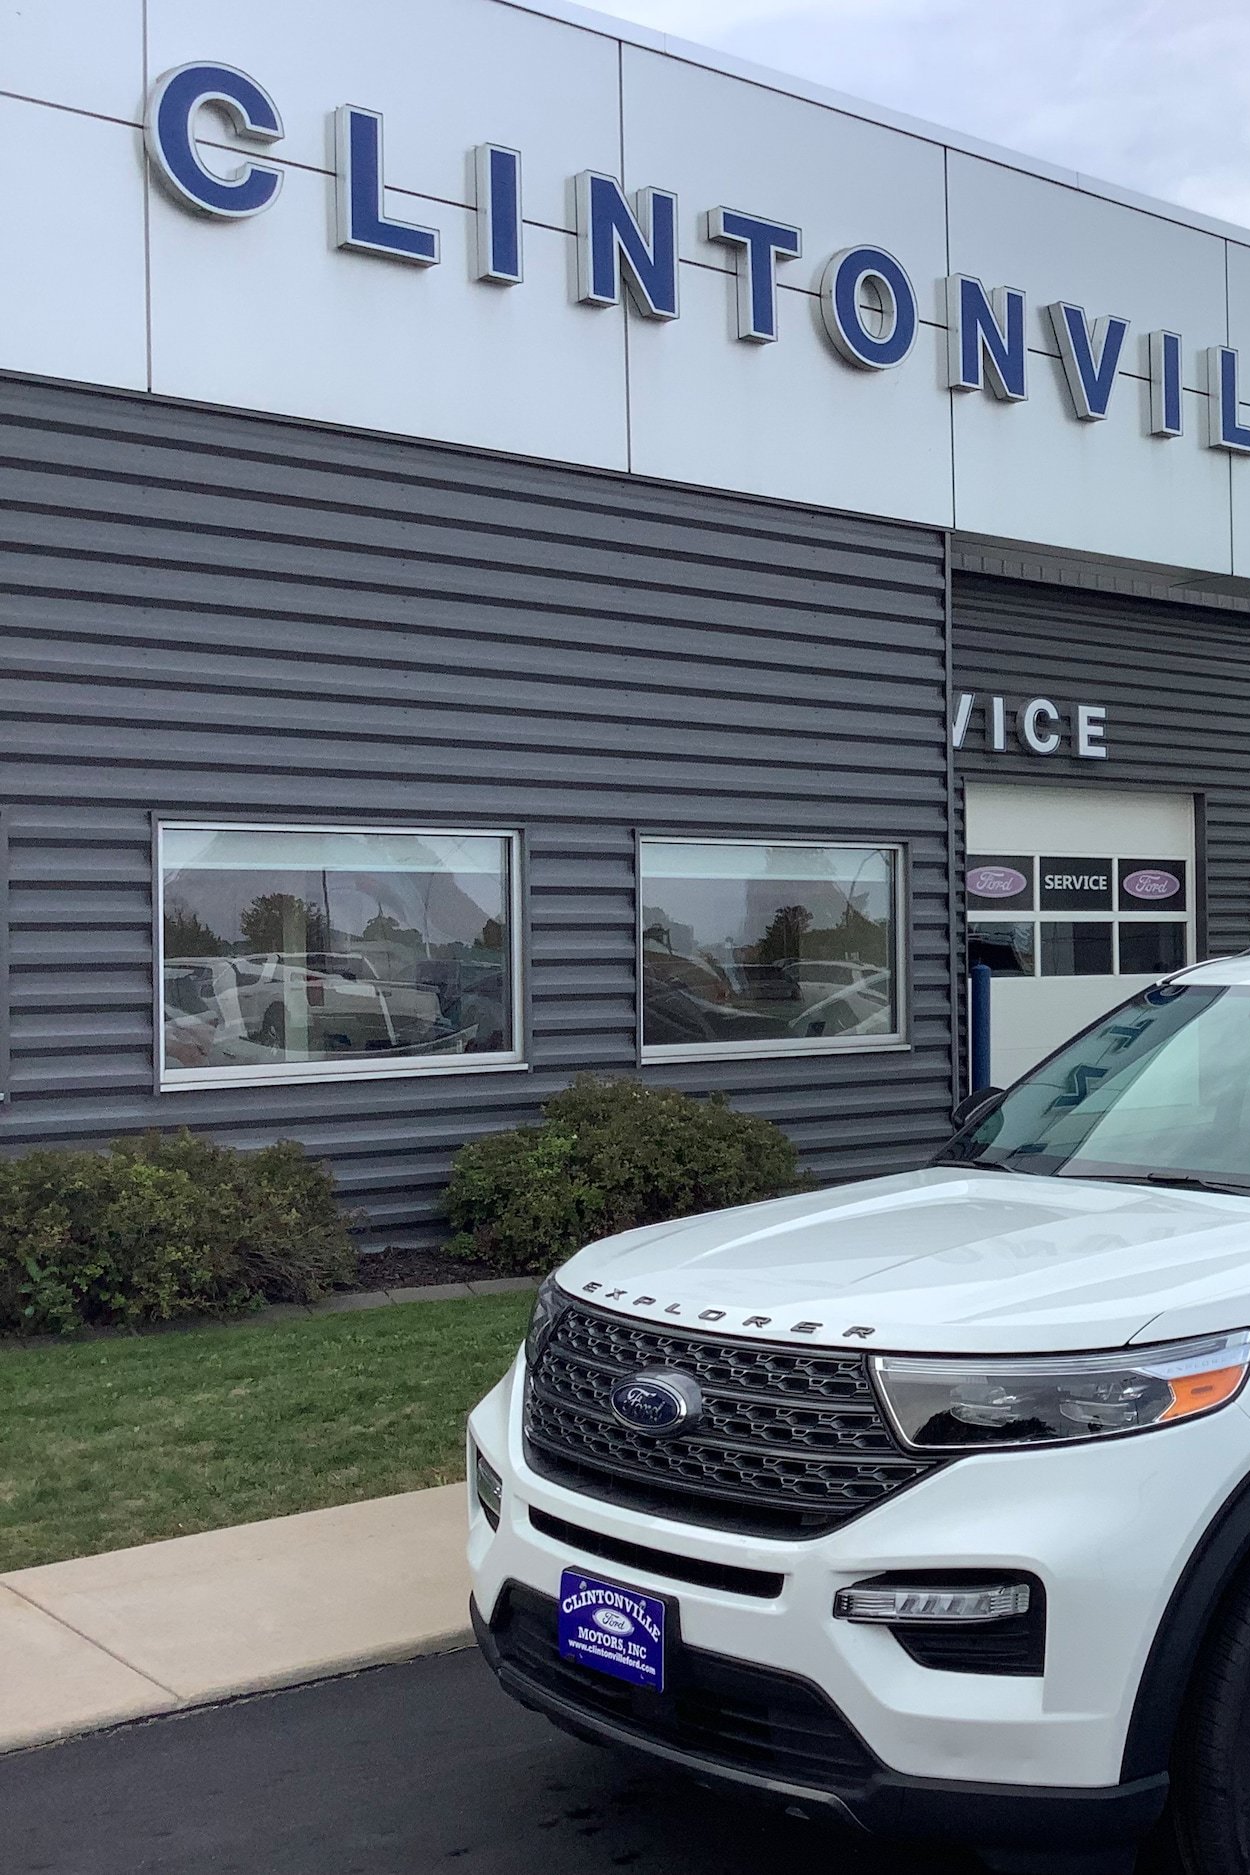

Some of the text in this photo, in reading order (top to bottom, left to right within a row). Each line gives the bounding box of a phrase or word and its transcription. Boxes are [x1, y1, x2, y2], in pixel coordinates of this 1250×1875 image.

[976, 870, 1014, 892] Ford
[1045, 874, 1108, 891] SERVICE
[1135, 873, 1168, 894] Ford
[582, 1281, 876, 1339] EXPLORER
[562, 1589, 661, 1643] CLINTONVILLE
[602, 1612, 625, 1630] Ford
[577, 1625, 647, 1660] MOTORS, INC
[568, 1640, 655, 1675] www.clintonvilleford.com
